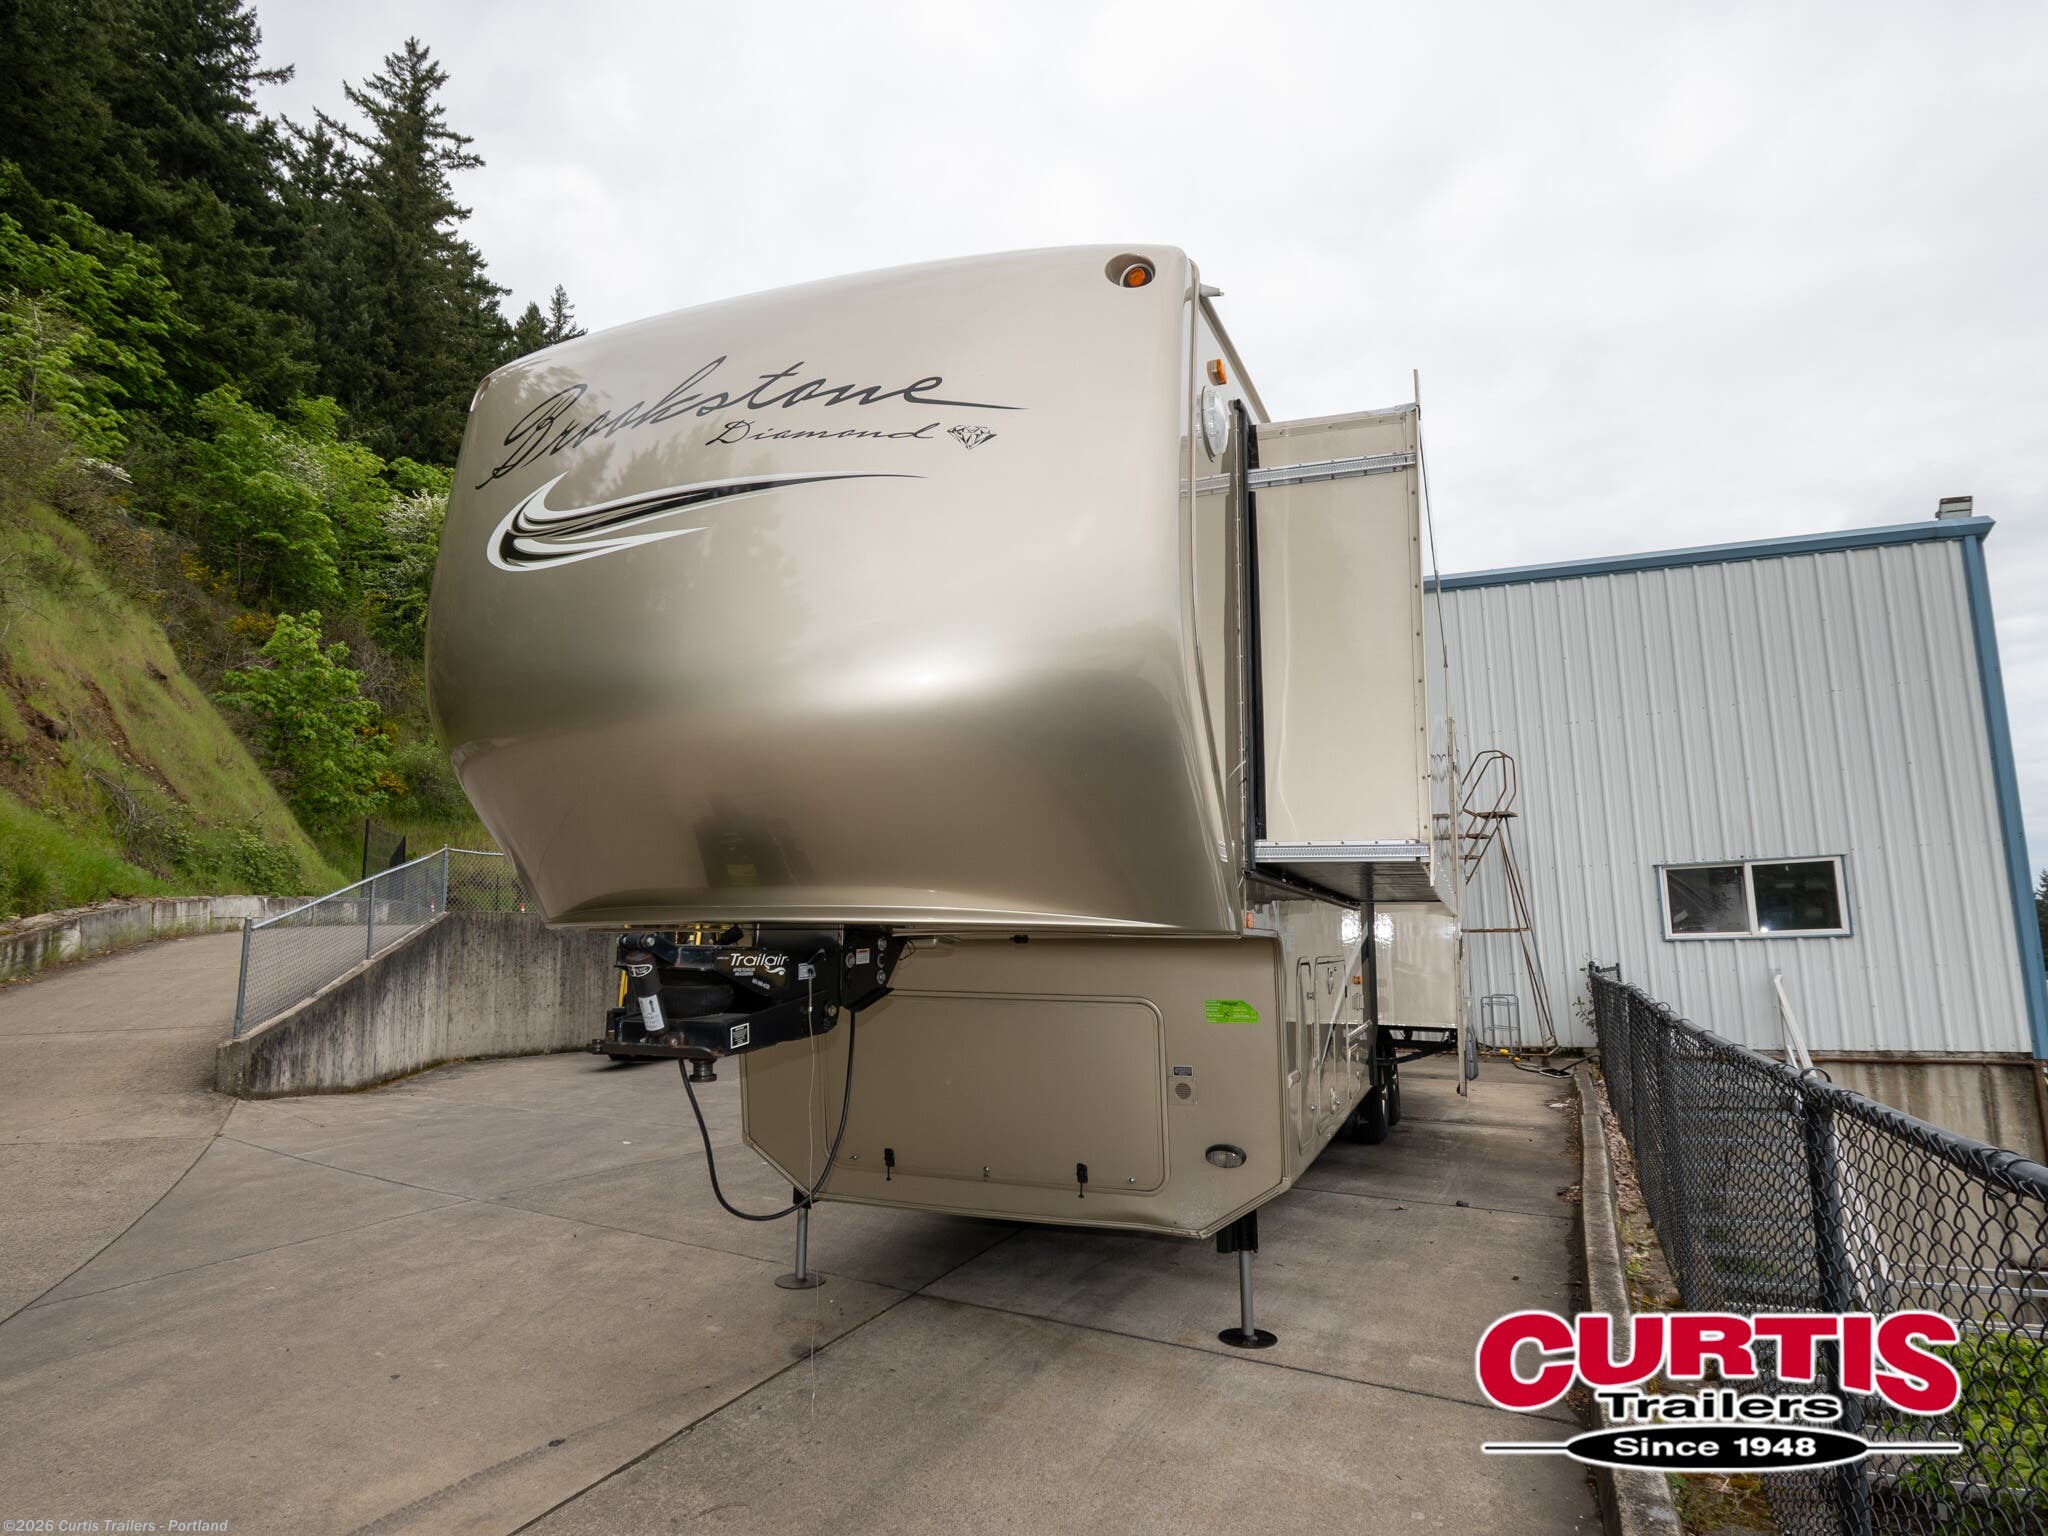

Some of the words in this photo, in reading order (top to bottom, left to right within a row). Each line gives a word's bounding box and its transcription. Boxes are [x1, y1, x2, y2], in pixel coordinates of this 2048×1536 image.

[475, 355, 1029, 490] Brookstone
[705, 419, 937, 446] Diamond
[730, 953, 788, 966] Trailair
